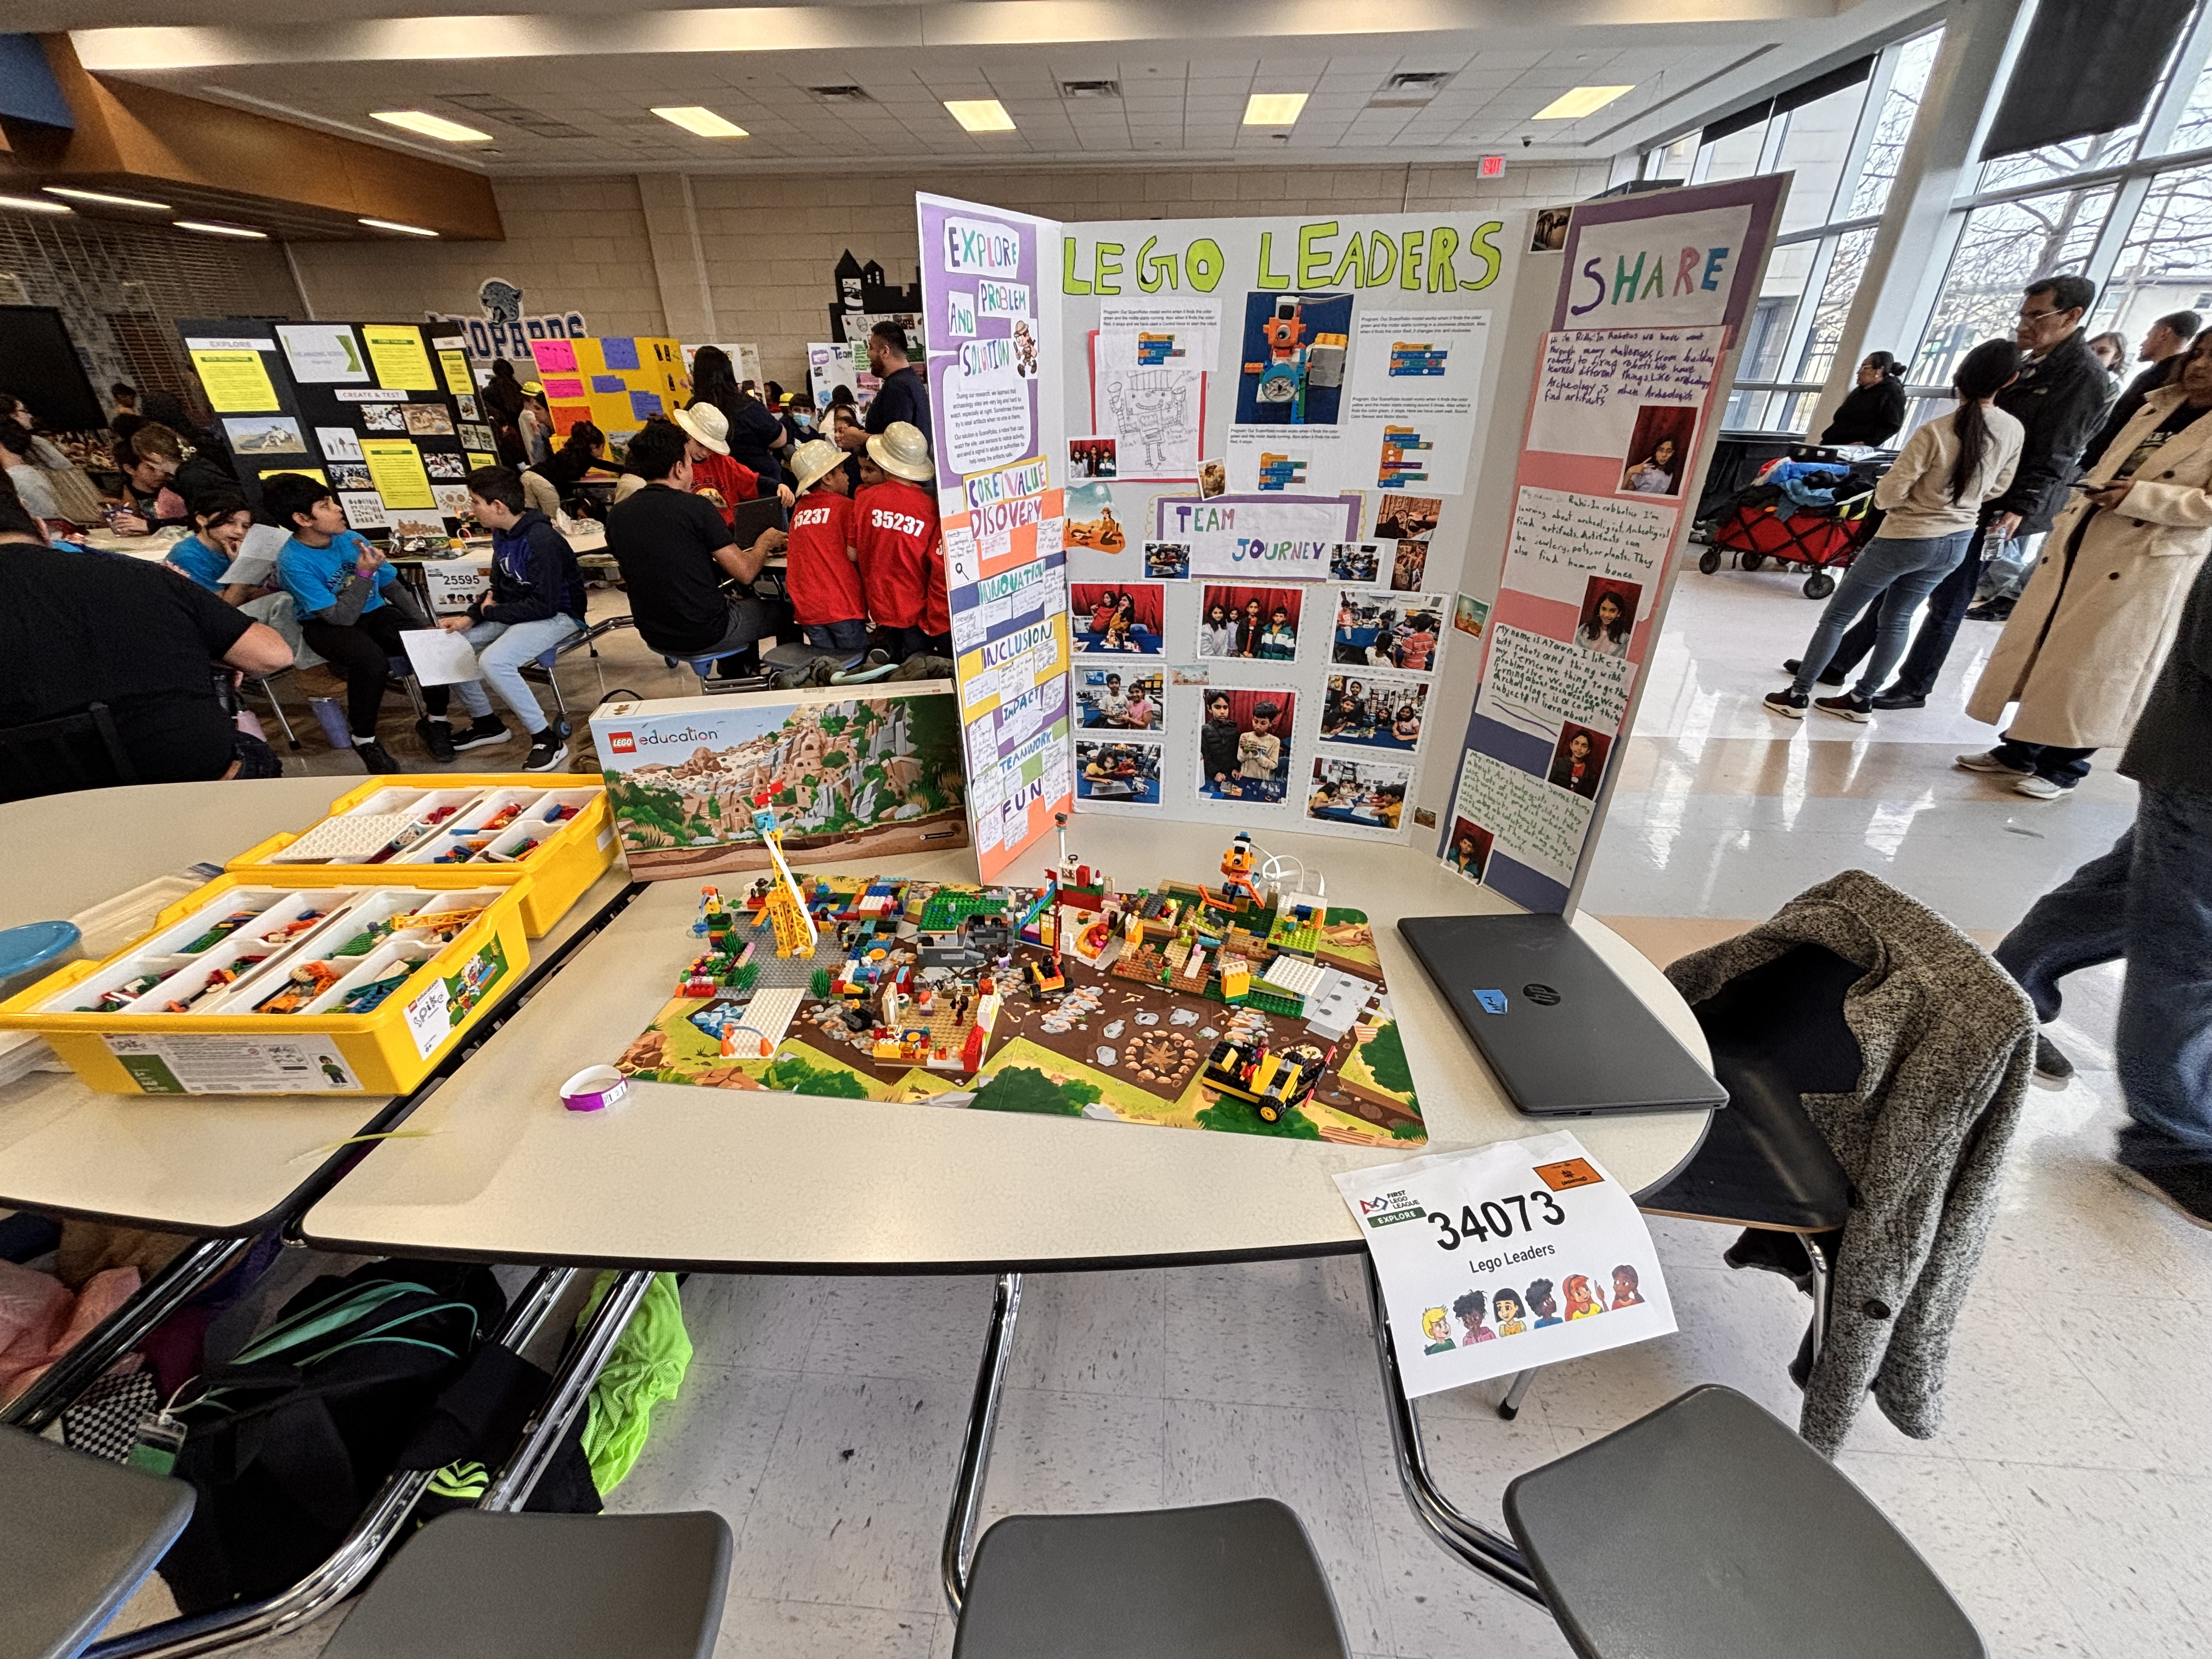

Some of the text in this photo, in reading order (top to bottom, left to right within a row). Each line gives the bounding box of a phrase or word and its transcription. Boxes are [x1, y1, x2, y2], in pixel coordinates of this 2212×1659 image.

[949, 227, 1017, 267] EXPLORE
[1063, 221, 1503, 295] LEGO LEADERS
[1571, 247, 1729, 316] SHARE
[981, 284, 1026, 312] PROBLEM
[950, 303, 974, 334] AND
[964, 338, 1009, 377] SOLUTION
[1578, 356, 1587, 364] to
[969, 461, 1047, 508] CORE VALUE
[872, 509, 924, 537] 35237
[970, 500, 1042, 540] DISOVERY
[1176, 506, 1235, 533] TEAM
[1517, 516, 1534, 527] find
[1552, 509, 1572, 521] about
[1232, 538, 1325, 562] JOURNEY
[1516, 531, 1526, 541] be
[1634, 552, 1654, 569] They
[1539, 549, 1558, 563] find
[1568, 557, 1596, 570] human
[444, 575, 480, 585] 25595
[983, 622, 1052, 669] INCLUSION
[1496, 625, 1509, 636] My
[1511, 630, 1530, 642] name
[1617, 660, 1626, 673] to
[1515, 644, 1541, 658] robots
[1543, 653, 1564, 665] and
[613, 726, 718, 747] LEGO education
[1000, 731, 1052, 774] TEAMWORK
[1003, 778, 1042, 823] FUN
[1387, 1190, 1406, 1198] FIRST
[1392, 1199, 1420, 1209] LEAGUE
[1378, 1211, 1417, 1224] EXPLORE
[1427, 1190, 1565, 1251] 34073
[1469, 1243, 1556, 1274] Lego Leaders
